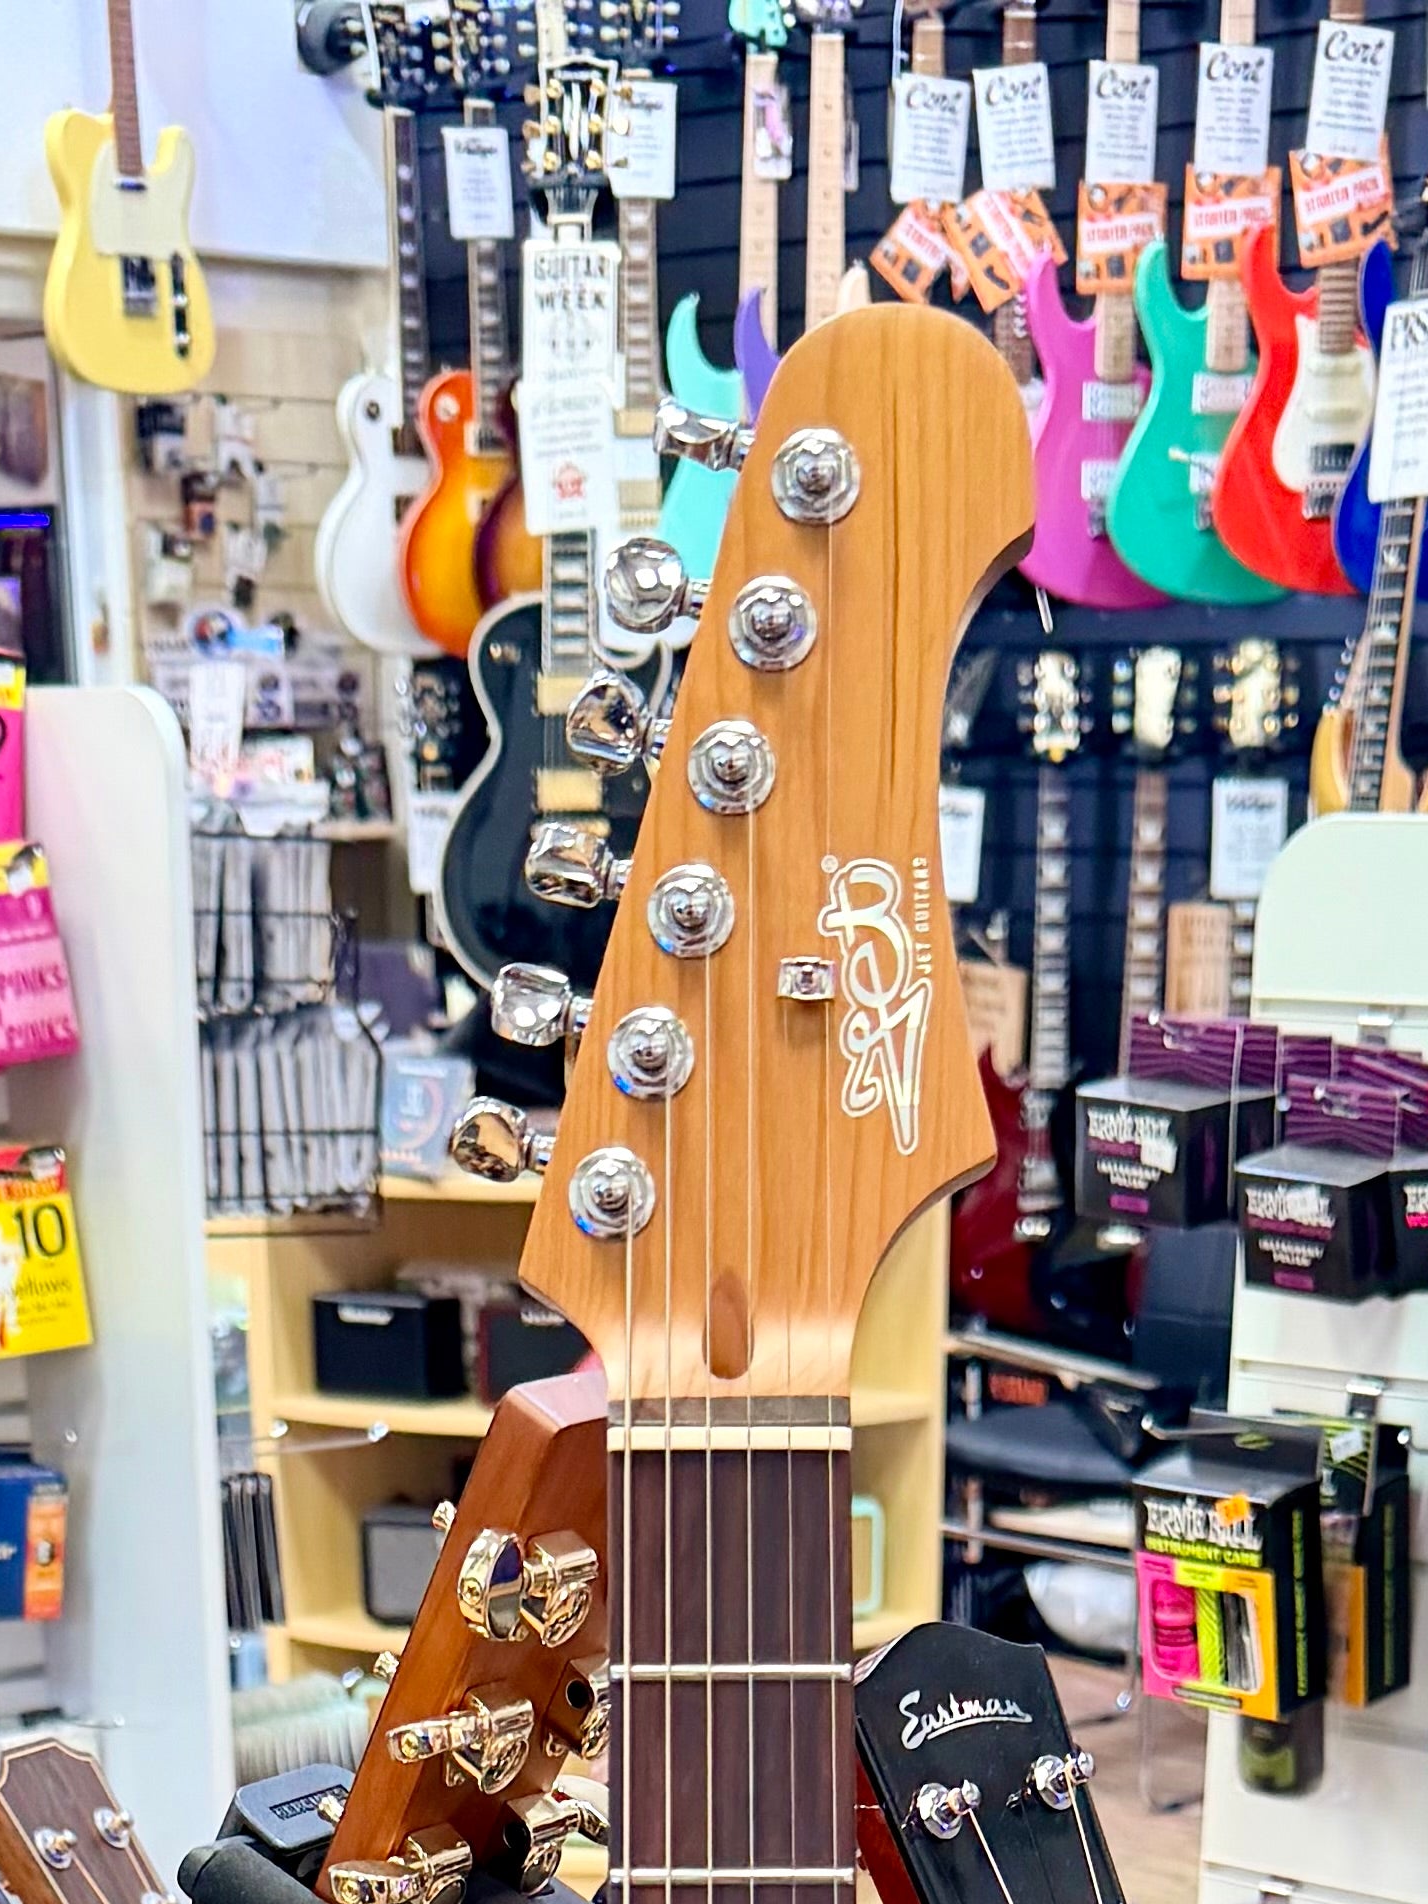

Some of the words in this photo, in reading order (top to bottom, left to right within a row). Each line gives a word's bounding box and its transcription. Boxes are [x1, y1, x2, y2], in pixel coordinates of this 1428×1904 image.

[1324, 30, 1386, 66] Cort
[1207, 51, 1265, 83] Cort
[906, 82, 963, 115] Cort
[986, 75, 1042, 106] Cort
[1096, 69, 1151, 103] Cort
[534, 252, 606, 280] GUITAR
[536, 286, 606, 310] WEEK
[911, 857, 929, 934] GUITARS
[914, 940, 932, 974] JET
[1088, 1107, 1134, 1143] ERNIE
[14, 1203, 66, 1261] 10
[1143, 1494, 1209, 1541] ERNIE
[1210, 1509, 1264, 1550] BALL
[1145, 1535, 1222, 1561] INSTRUMENT
[1224, 1547, 1262, 1568] CARE
[899, 1690, 1033, 1750] Eastman
